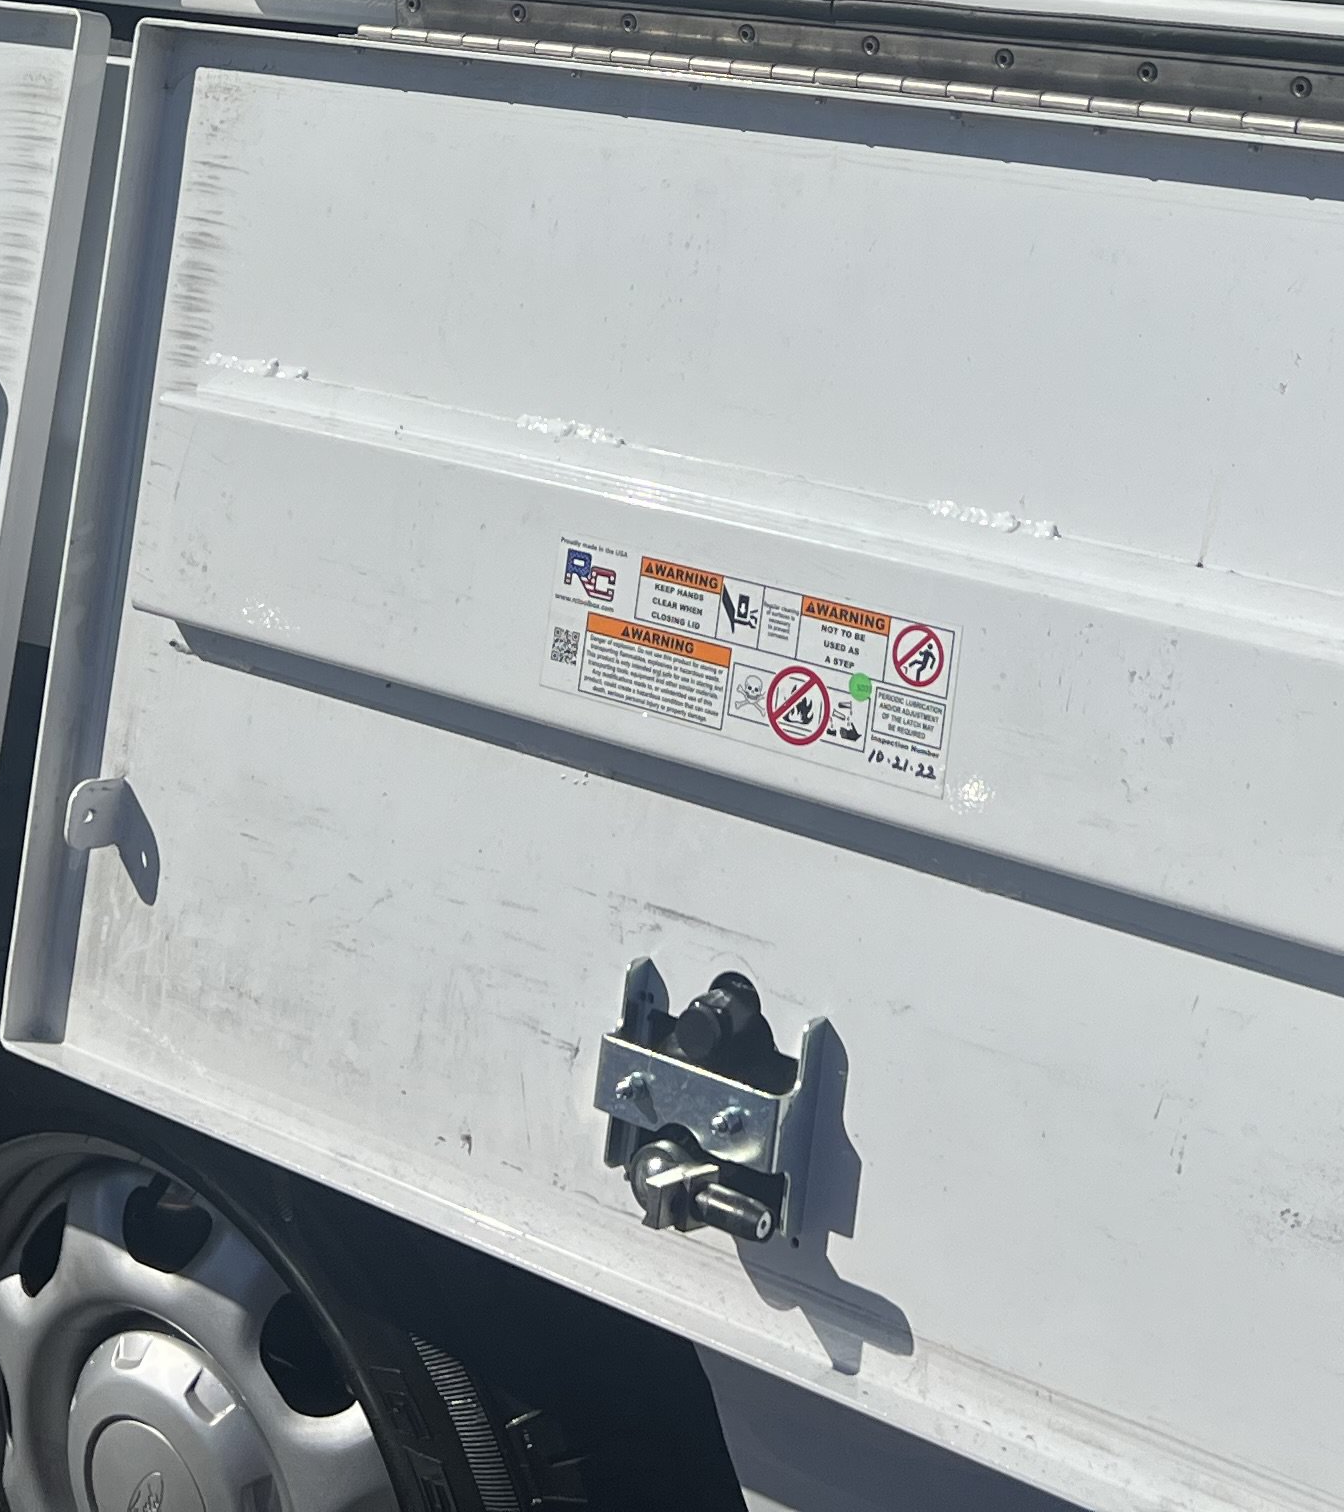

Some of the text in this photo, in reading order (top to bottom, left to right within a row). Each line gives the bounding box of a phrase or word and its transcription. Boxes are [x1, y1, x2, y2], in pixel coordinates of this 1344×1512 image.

[615, 548, 627, 558] USA
[564, 548, 617, 602] RC
[655, 563, 718, 589] WARNING
[653, 582, 704, 602] KEEP HANDS
[651, 596, 703, 616] CLEAR WHEN
[815, 602, 885, 630] WARNING
[650, 610, 700, 630] CLOSING LID
[632, 627, 694, 654] WARNING
[820, 623, 865, 642] NOT TO BE
[823, 639, 859, 656] USED AS
[824, 655, 854, 670] A STEP
[870, 734, 939, 758] Inspection Number
